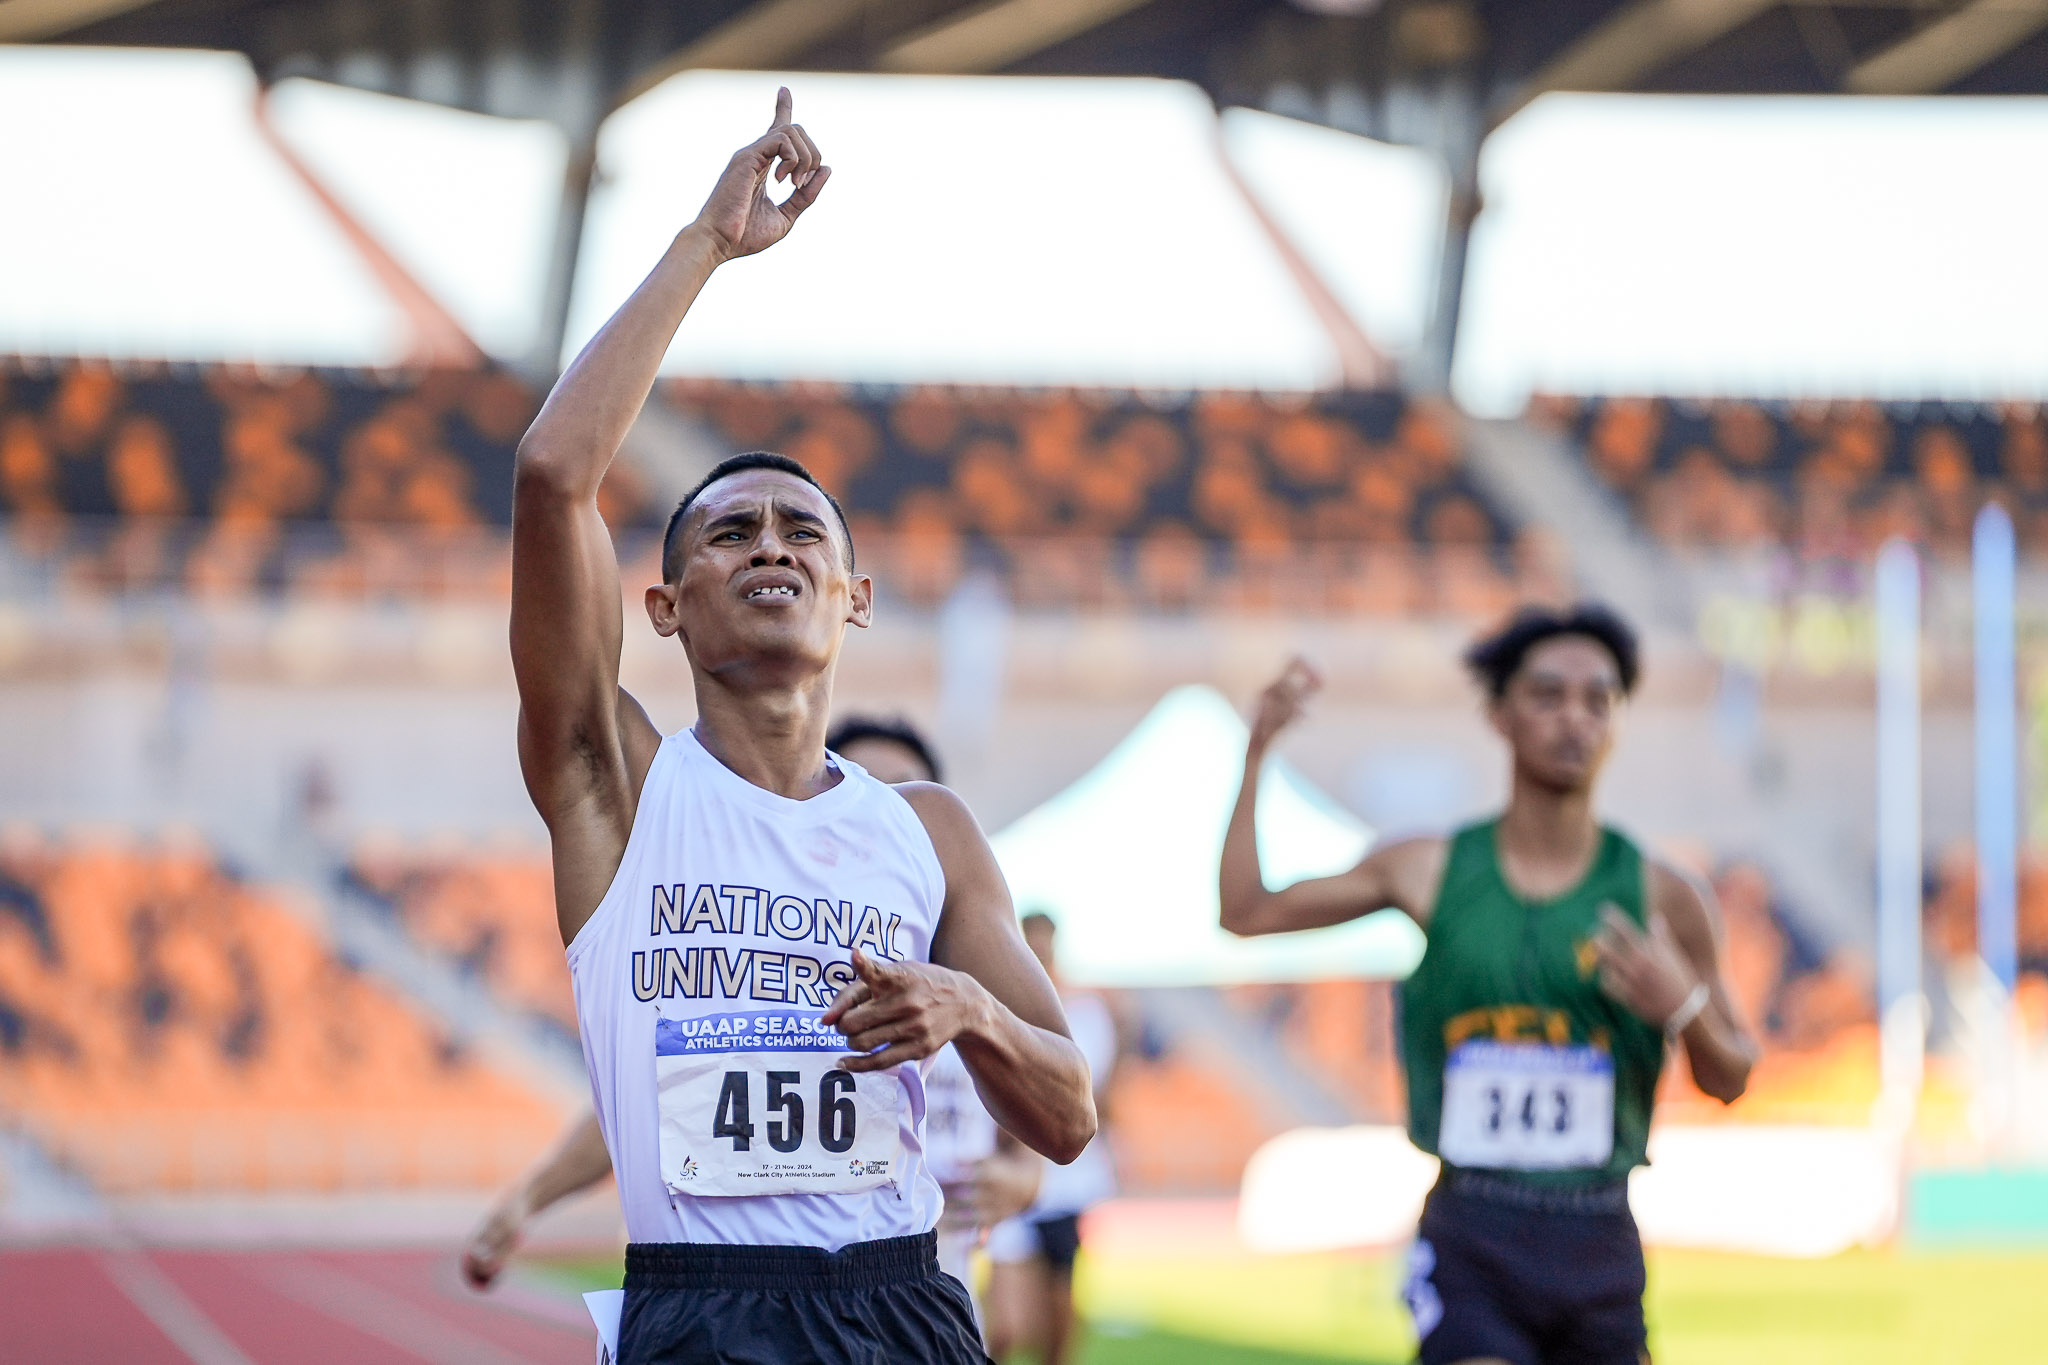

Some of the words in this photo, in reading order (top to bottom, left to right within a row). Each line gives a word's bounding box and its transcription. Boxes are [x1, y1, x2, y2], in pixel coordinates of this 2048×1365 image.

[651, 883, 904, 961] NATIONAL
[632, 947, 857, 1008] UNIVERS
[681, 1017, 748, 1037] UAAP
[685, 1035, 761, 1050] ATHLETICS
[712, 1069, 857, 1154] 456
